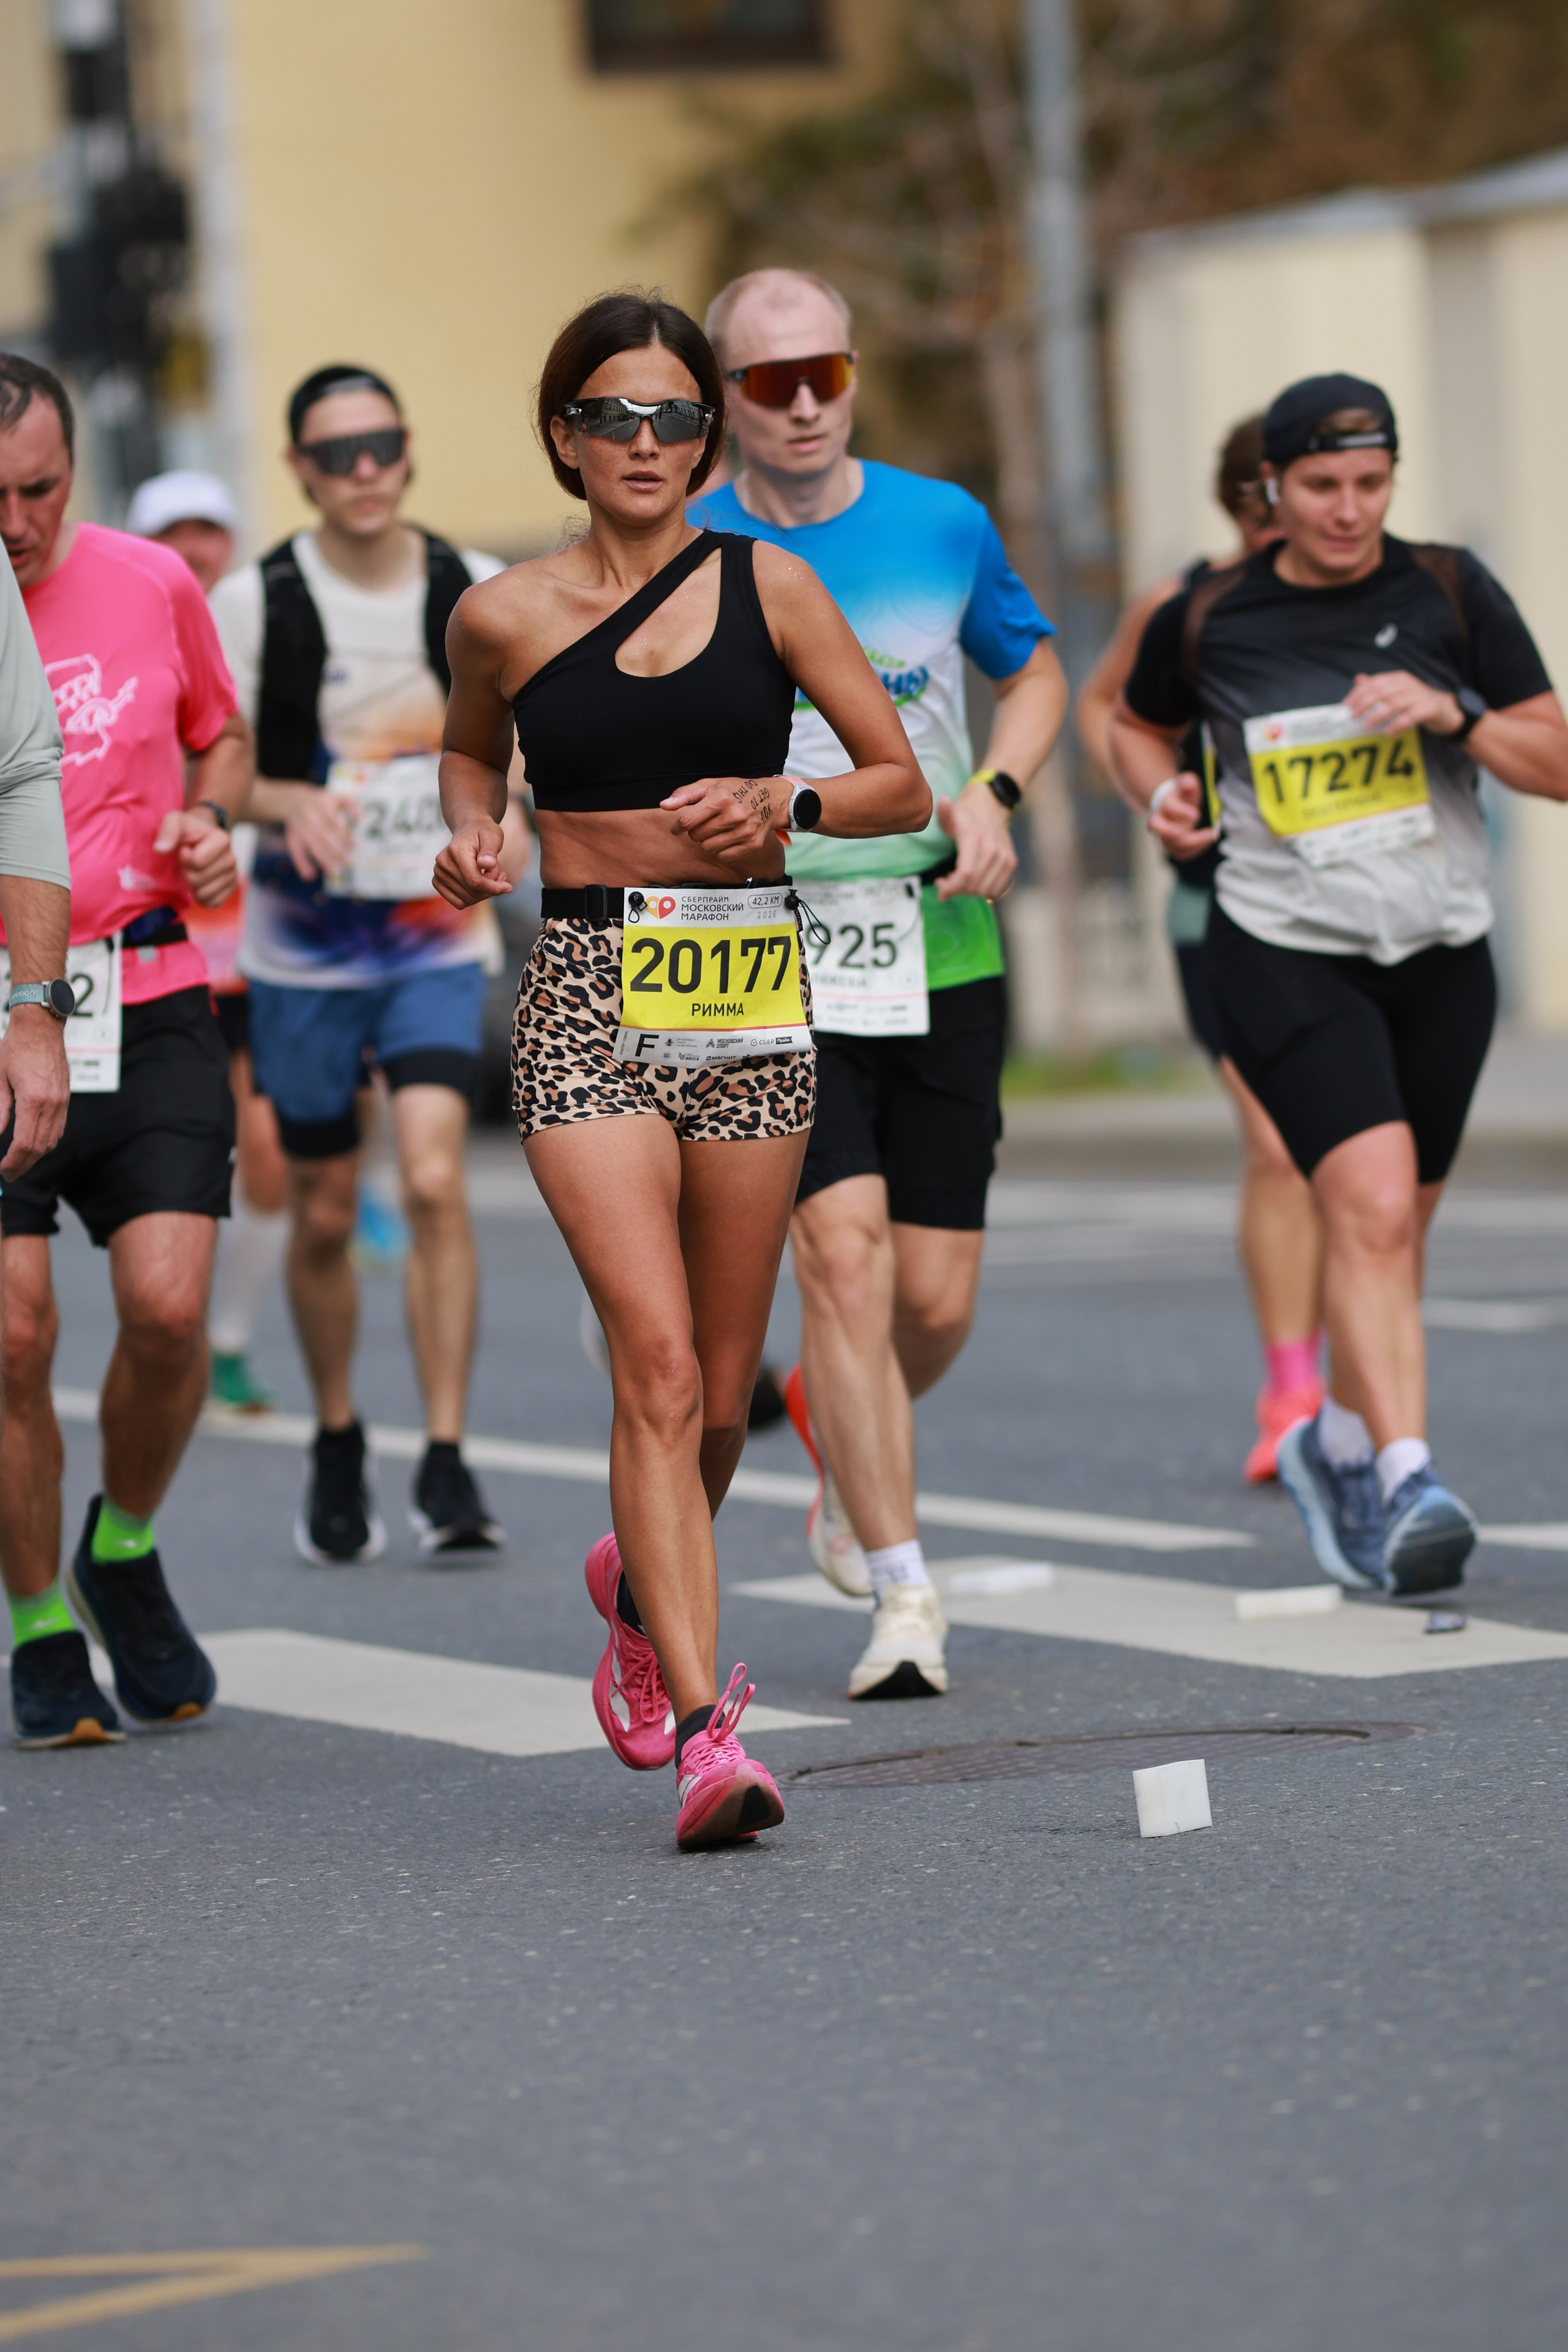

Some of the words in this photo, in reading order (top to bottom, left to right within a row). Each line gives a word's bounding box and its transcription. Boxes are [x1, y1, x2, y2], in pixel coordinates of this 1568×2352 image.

[1265, 739, 1415, 803] 17274
[744, 780, 758, 789] DO
[733, 786, 748, 804] THIS
[758, 788, 770, 802] GET
[750, 796, 759, 810] TO
[761, 803, 772, 823] YOU
[682, 902, 744, 911] МОСКОВСКИЙ
[753, 897, 768, 906] 42,2
[770, 896, 779, 905] КМ
[630, 935, 791, 993] 20177
[692, 1003, 744, 1016] РИММА
[635, 1033, 659, 1057] F
